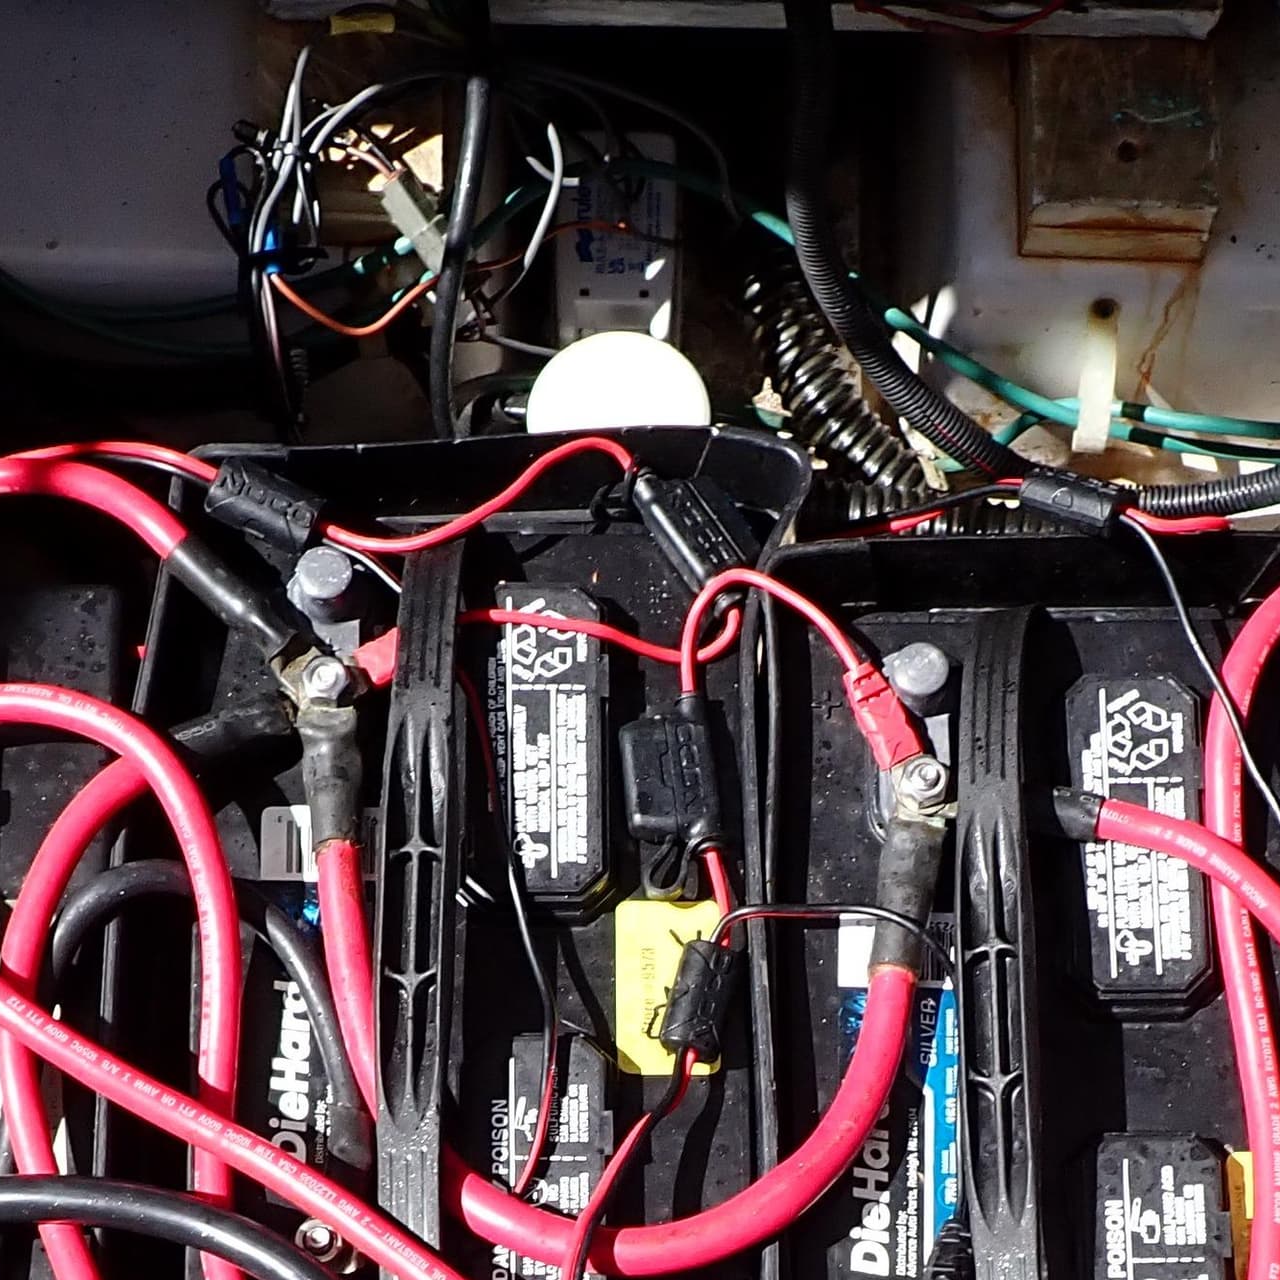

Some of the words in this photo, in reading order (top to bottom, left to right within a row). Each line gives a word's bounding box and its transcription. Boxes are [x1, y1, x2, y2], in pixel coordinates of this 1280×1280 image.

[1245, 943, 1258, 967] BOAT
[920, 998, 936, 1065] SILVER
[101, 1059, 120, 1076] A/B
[133, 1078, 159, 1097] AWM
[1266, 1075, 1280, 1097] AWG
[161, 1092, 177, 1107] OR
[181, 1102, 197, 1118] FT1
[492, 1099, 508, 1174] POISON
[897, 1210, 907, 1225] by:
[907, 1217, 918, 1237] Auto
[1105, 1200, 1125, 1278] POISON
[382, 1232, 430, 1270] RESISTANT
[897, 1227, 907, 1275] Distributed
[907, 1240, 918, 1277] Advance
[1269, 1262, 1280, 1280] FT2
